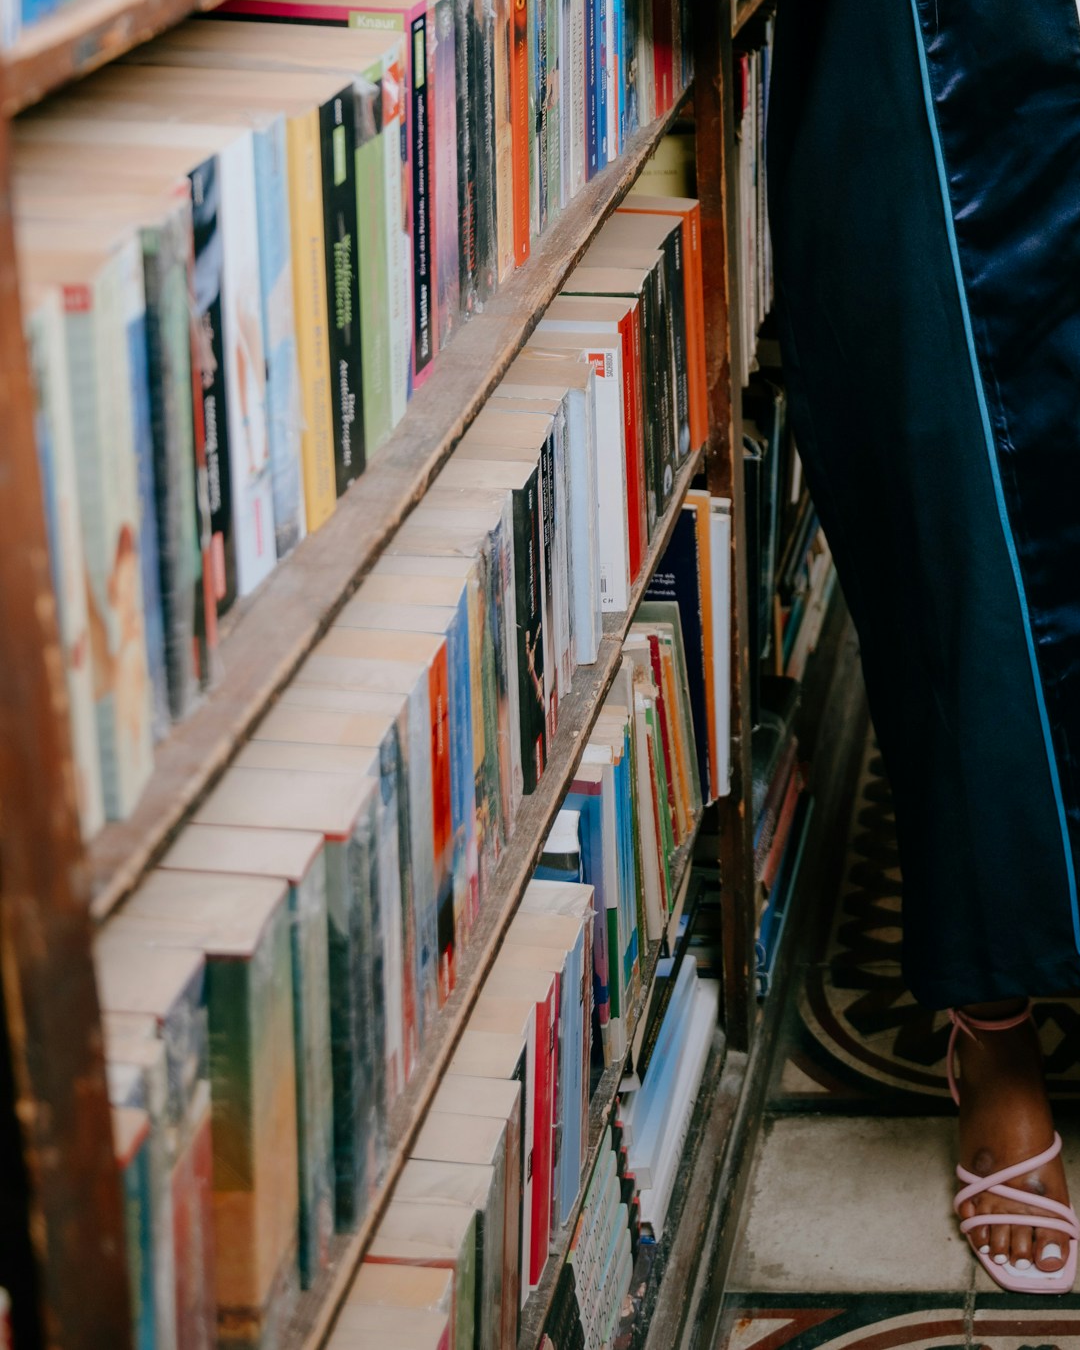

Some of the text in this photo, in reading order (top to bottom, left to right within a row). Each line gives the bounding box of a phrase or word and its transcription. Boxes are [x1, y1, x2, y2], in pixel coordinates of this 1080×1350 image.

[356, 14, 397, 29] Knaur
[420, 284, 428, 328] Heller
[420, 329, 428, 358] Eva
[605, 352, 614, 378] SACHBUCH
